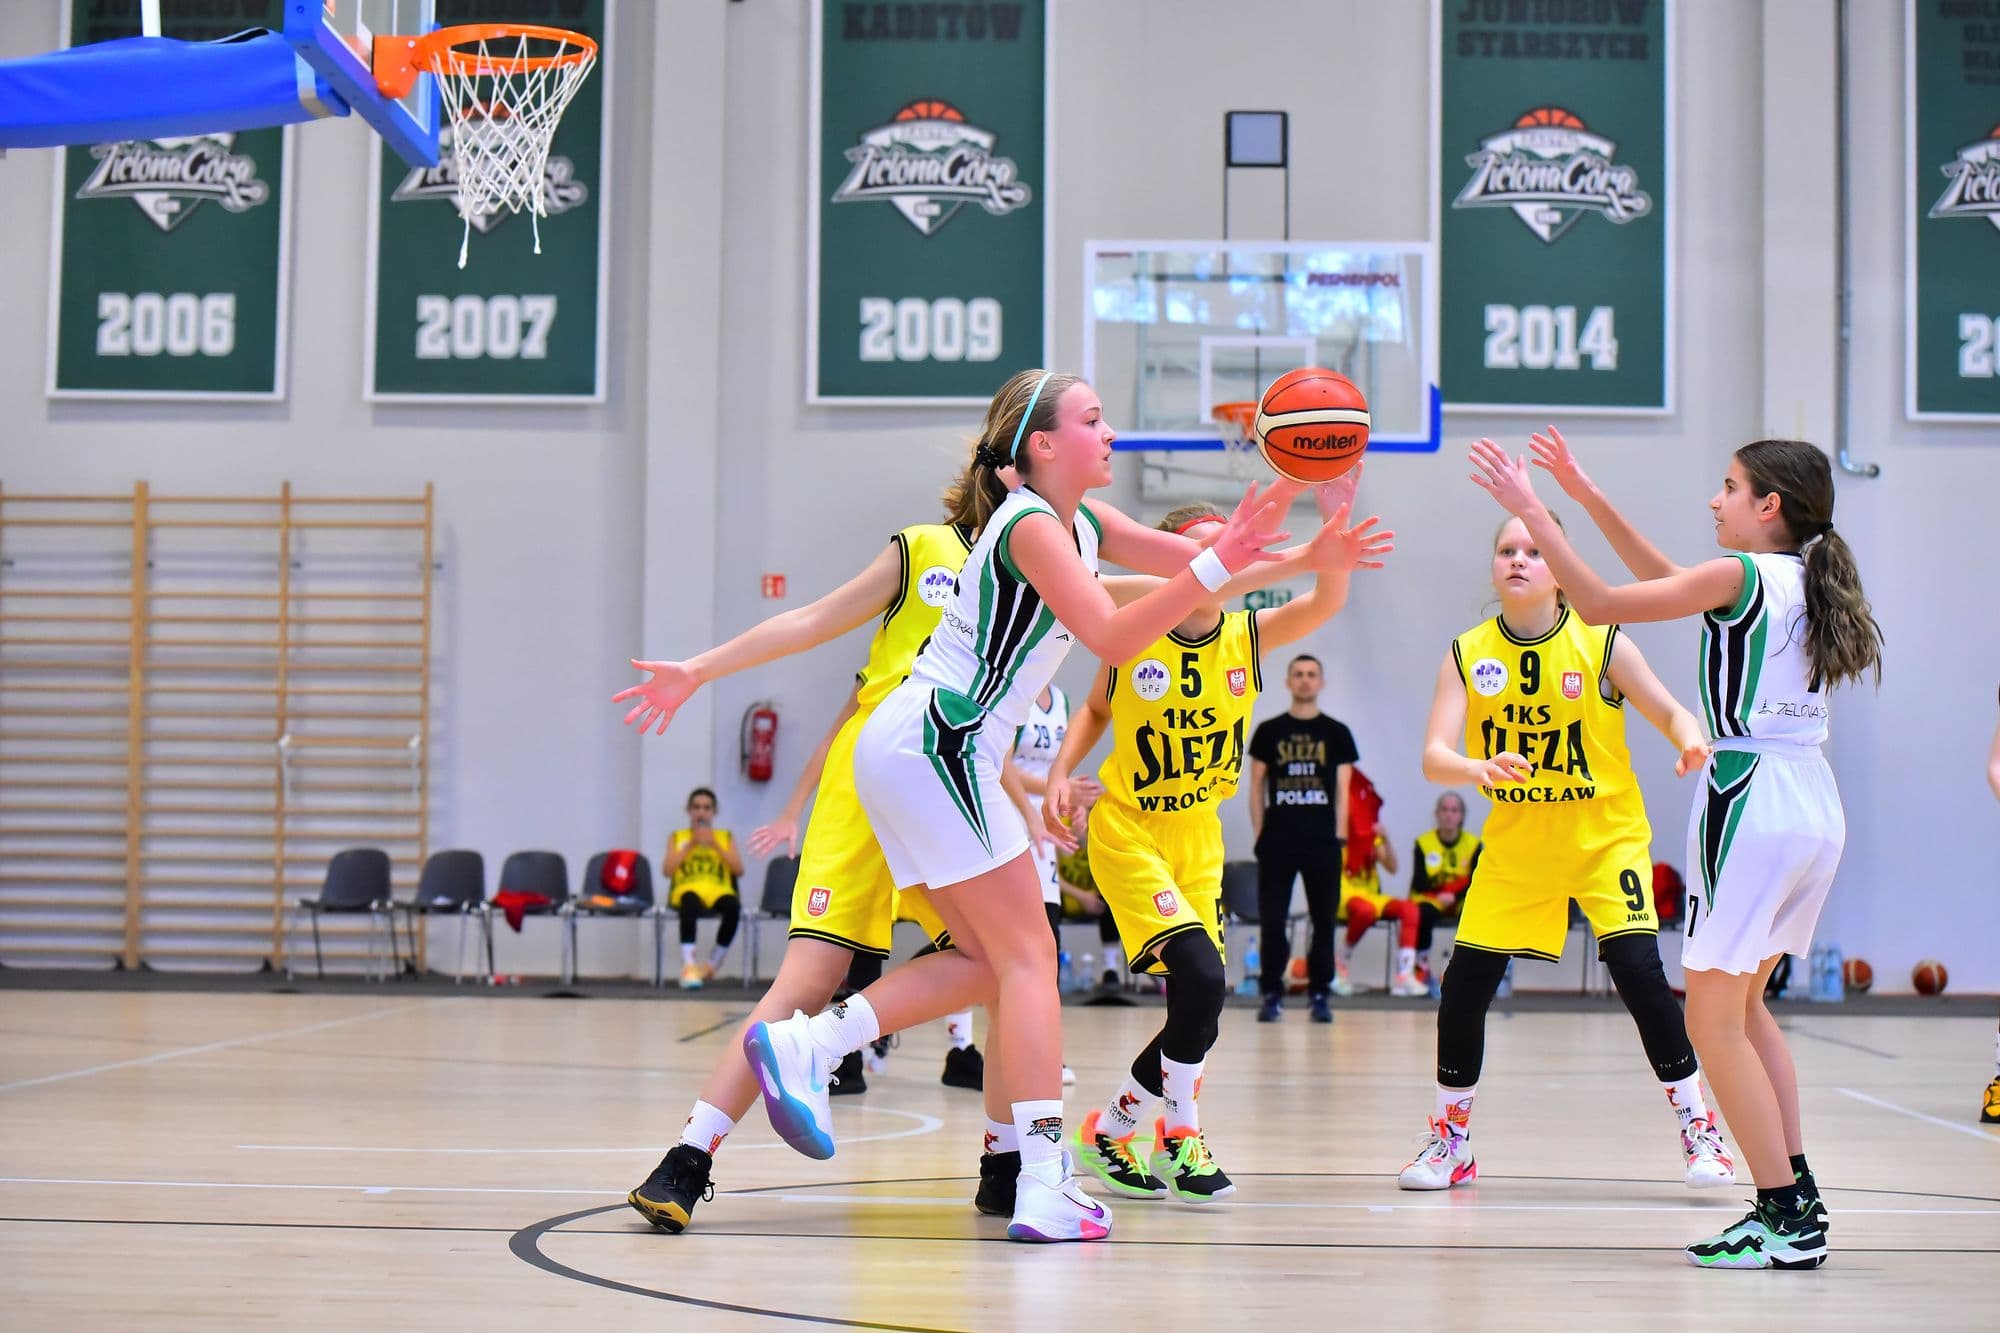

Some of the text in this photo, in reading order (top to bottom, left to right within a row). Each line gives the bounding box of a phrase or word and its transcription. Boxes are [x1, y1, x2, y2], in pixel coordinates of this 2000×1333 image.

[97, 292, 236, 357] 2006
[415, 294, 557, 359] 2007
[859, 297, 1002, 362] 2009
[1484, 304, 1618, 370] 2014
[1293, 434, 1357, 450] molten
[1181, 653, 1201, 698] 5
[1520, 650, 1540, 695] 9
[1034, 724, 1050, 749] 29
[1619, 869, 1645, 911] 9
[1626, 913, 1649, 922] JAKO
